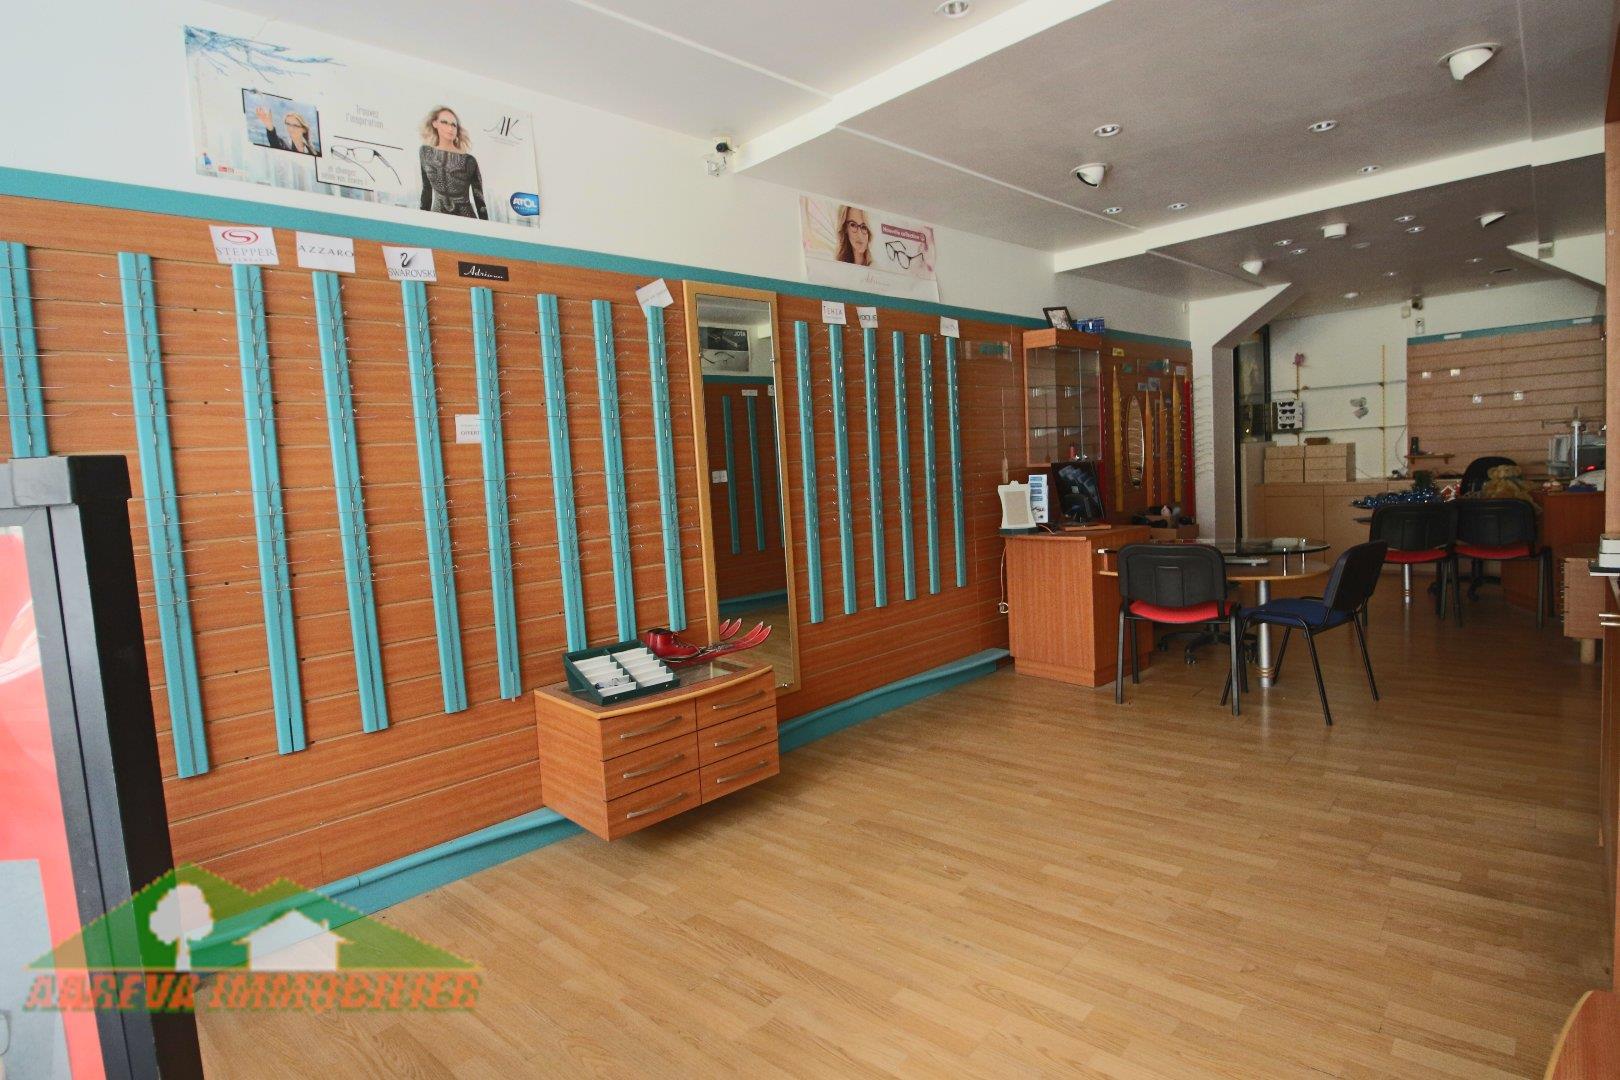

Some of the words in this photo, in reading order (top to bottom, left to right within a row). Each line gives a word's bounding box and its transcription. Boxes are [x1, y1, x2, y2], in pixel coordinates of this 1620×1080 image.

[512, 197, 538, 209] ATOL
[215, 246, 276, 257] STEPPER
[298, 244, 355, 257] AZZARO
[388, 267, 436, 278] SWAROVSKI
